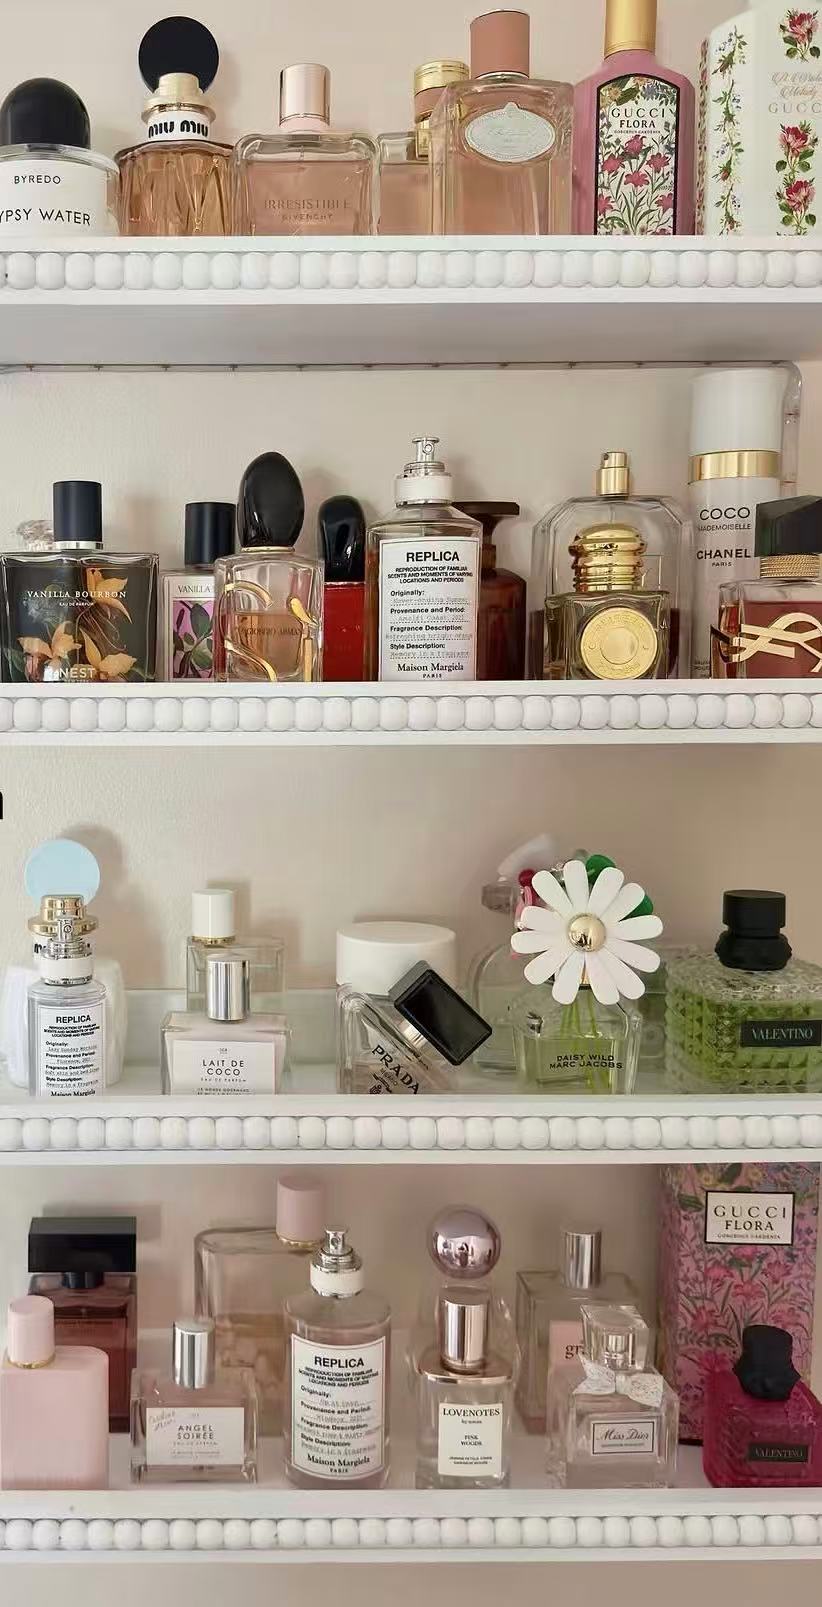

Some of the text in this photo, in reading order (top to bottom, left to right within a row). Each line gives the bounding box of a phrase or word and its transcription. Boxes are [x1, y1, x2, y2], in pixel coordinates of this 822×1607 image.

[612, 108, 664, 118] GUCCI
[14, 175, 61, 184] BYREDO
[39, 208, 90, 226] WATER
[700, 507, 750, 520] COCO
[407, 552, 460, 562] REPLICA
[697, 549, 751, 559] CHANEL
[178, 585, 211, 593] VANILLA
[431, 663, 463, 672] Margiela
[59, 668, 95, 678] NEST
[56, 1015, 91, 1023] REPLICA
[752, 1028, 813, 1040] VALENTINO
[372, 1044, 419, 1094] PRADA
[550, 1061, 575, 1070] MARC
[714, 1205, 786, 1219] GUCCI
[726, 1220, 774, 1231] FLORA
[314, 1356, 364, 1368] REPLICA
[301, 1401, 335, 1414] Provenance
[443, 1408, 500, 1417] LOVENOTES
[602, 1428, 649, 1441] Miss Dior
[756, 1448, 803, 1456] VALENTINO
[308, 1453, 370, 1467] Maison Margiela
